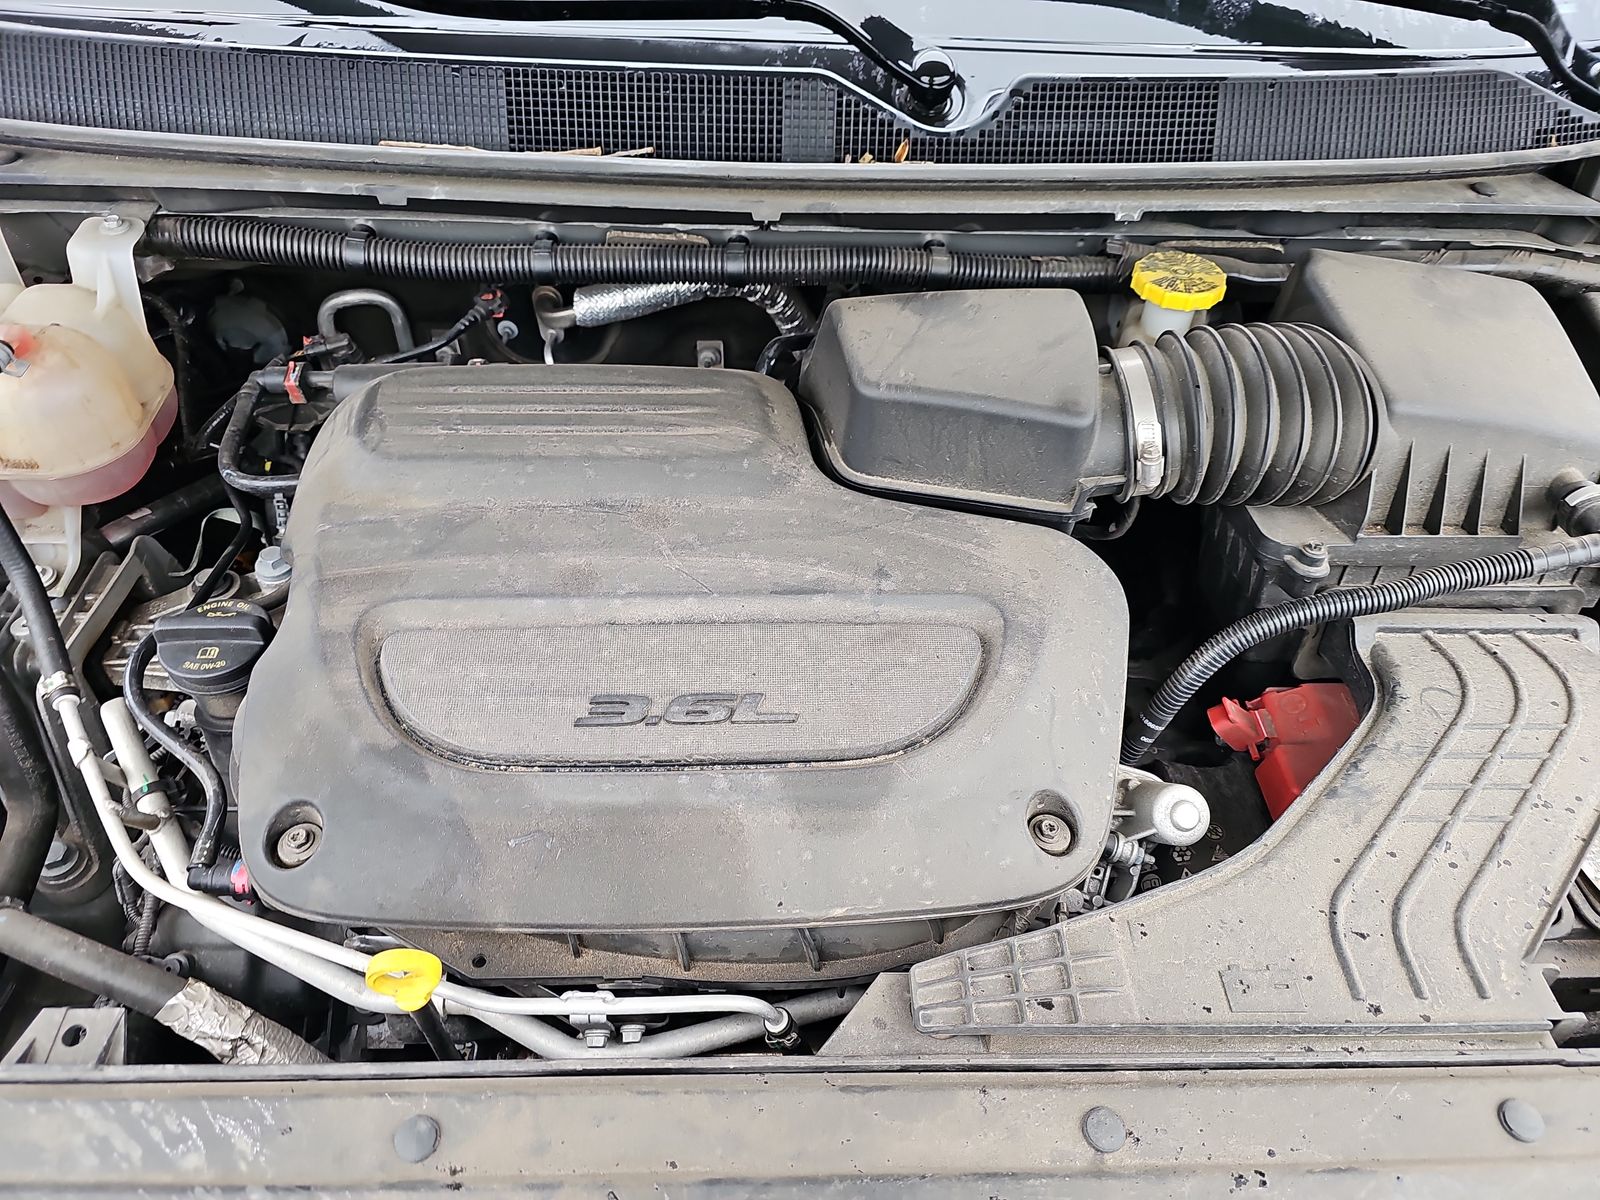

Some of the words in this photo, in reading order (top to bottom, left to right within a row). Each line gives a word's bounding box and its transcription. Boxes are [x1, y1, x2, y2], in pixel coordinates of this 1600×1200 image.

[197, 601, 234, 613] ENGINE
[237, 601, 250, 610] OIL
[183, 661, 200, 671] SAE
[574, 692, 799, 727] 3.6L
